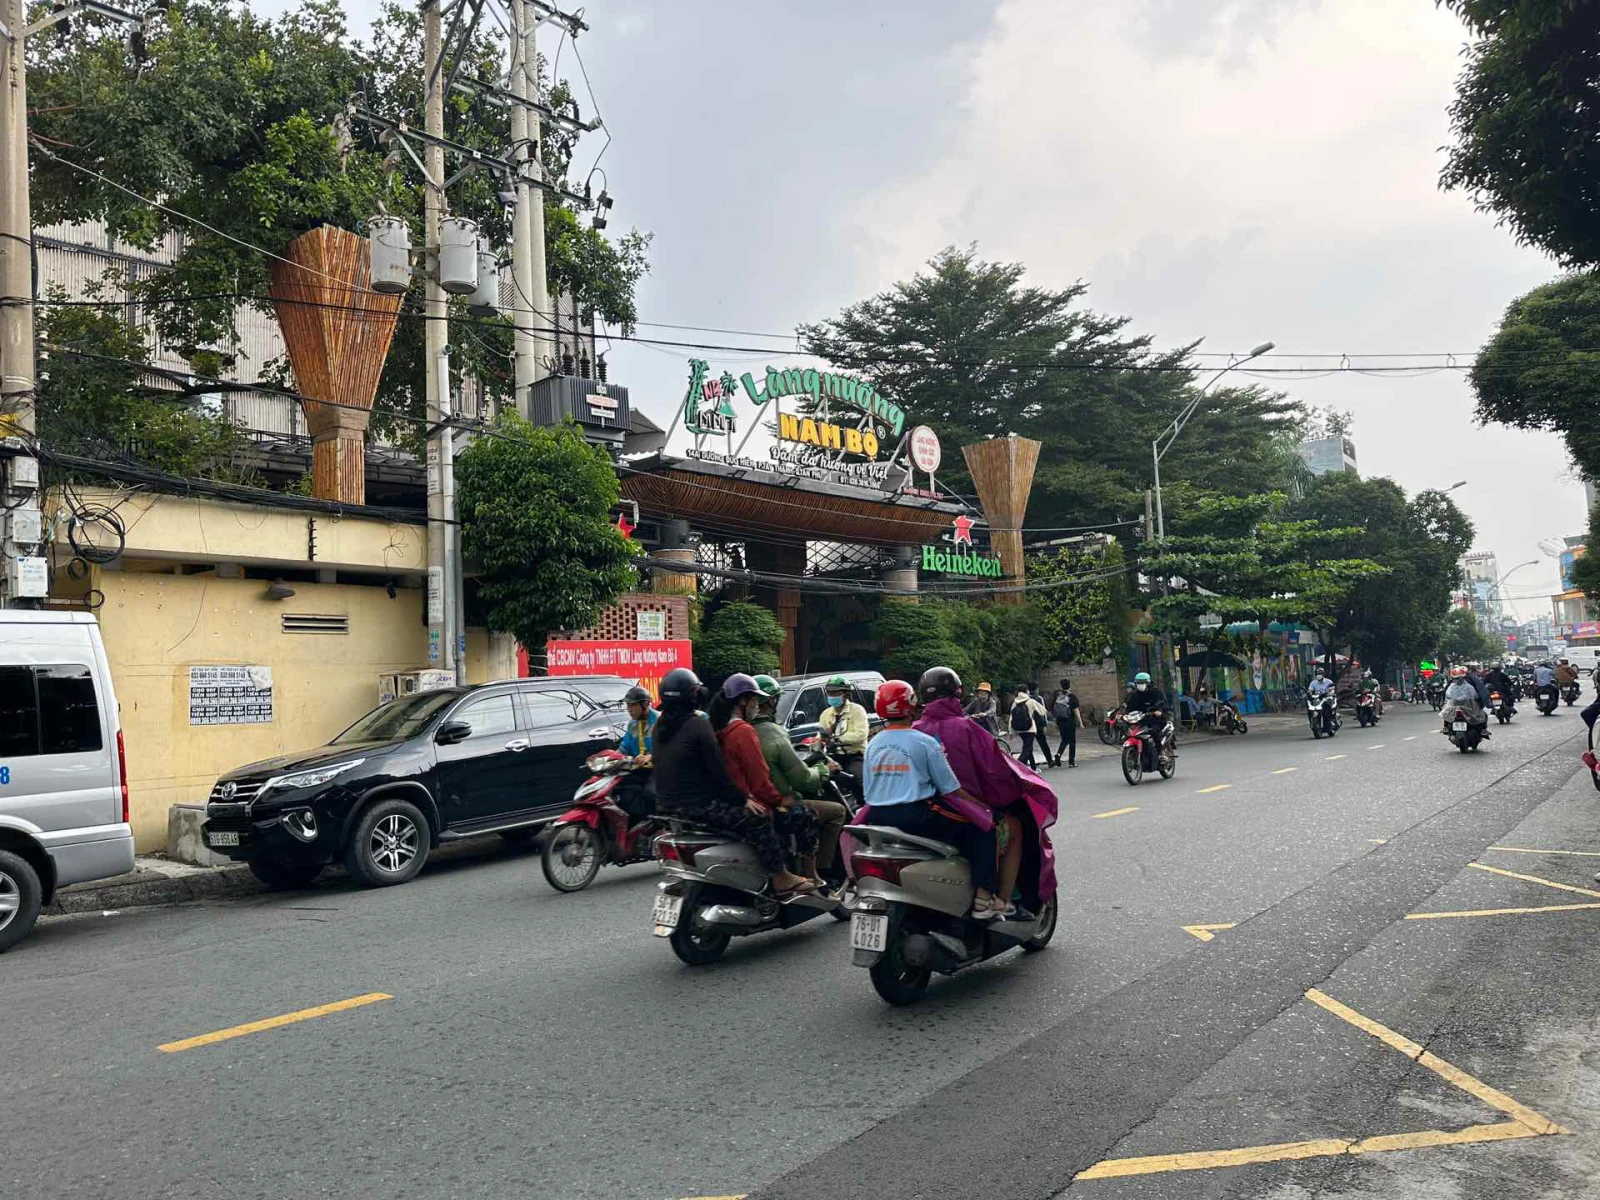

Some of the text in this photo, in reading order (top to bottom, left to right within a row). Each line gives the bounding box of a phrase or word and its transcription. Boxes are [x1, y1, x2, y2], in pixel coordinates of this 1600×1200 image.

[740, 365, 820, 406] Làng
[778, 412, 879, 461] NAM BỘ
[921, 544, 1001, 577] Heineken
[854, 932, 880, 948] 4026
